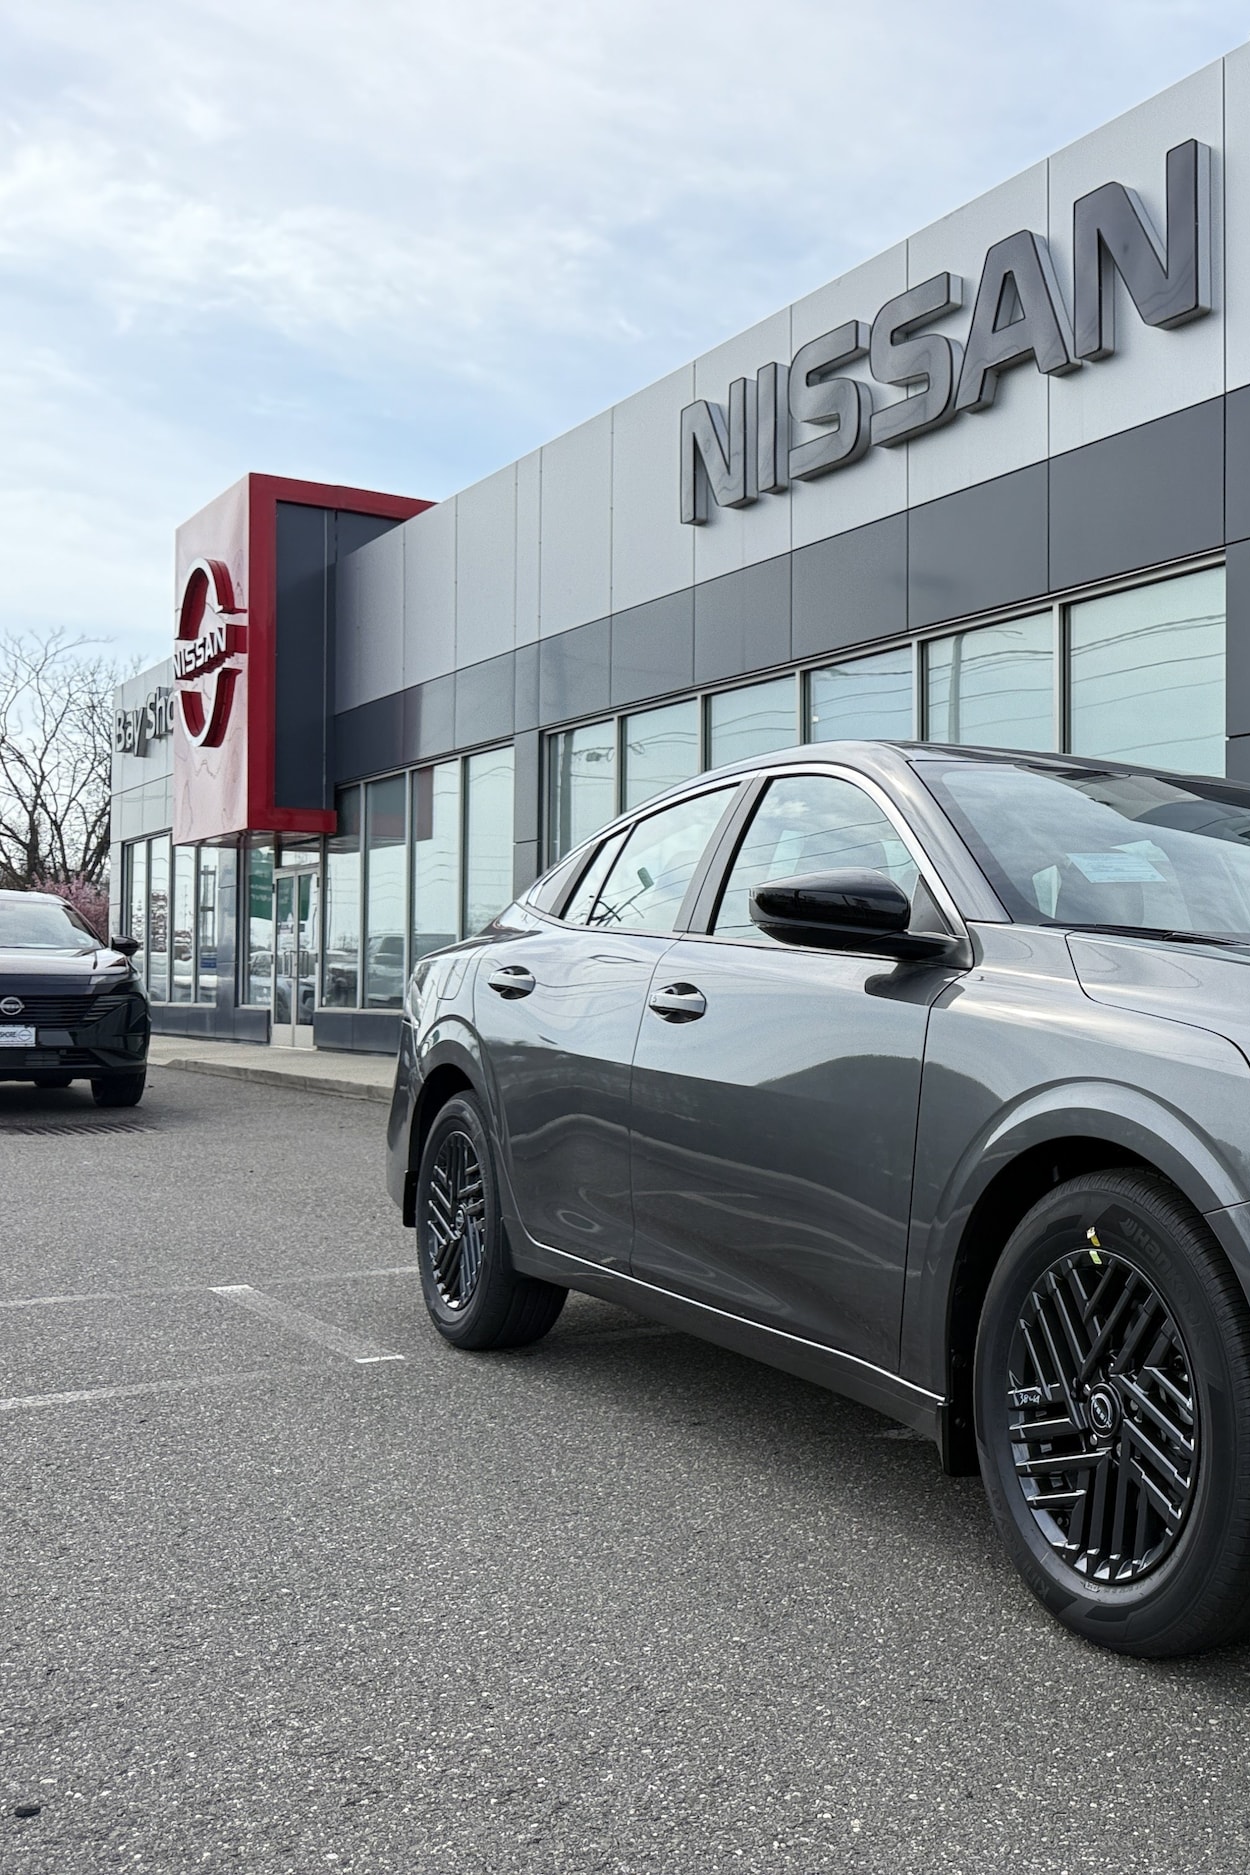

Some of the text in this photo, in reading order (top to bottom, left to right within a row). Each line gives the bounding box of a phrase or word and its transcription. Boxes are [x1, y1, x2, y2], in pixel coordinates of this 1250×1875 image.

[680, 138, 1211, 525] NISSAN
[173, 625, 227, 679] NISSAN
[114, 706, 147, 758] Bay
